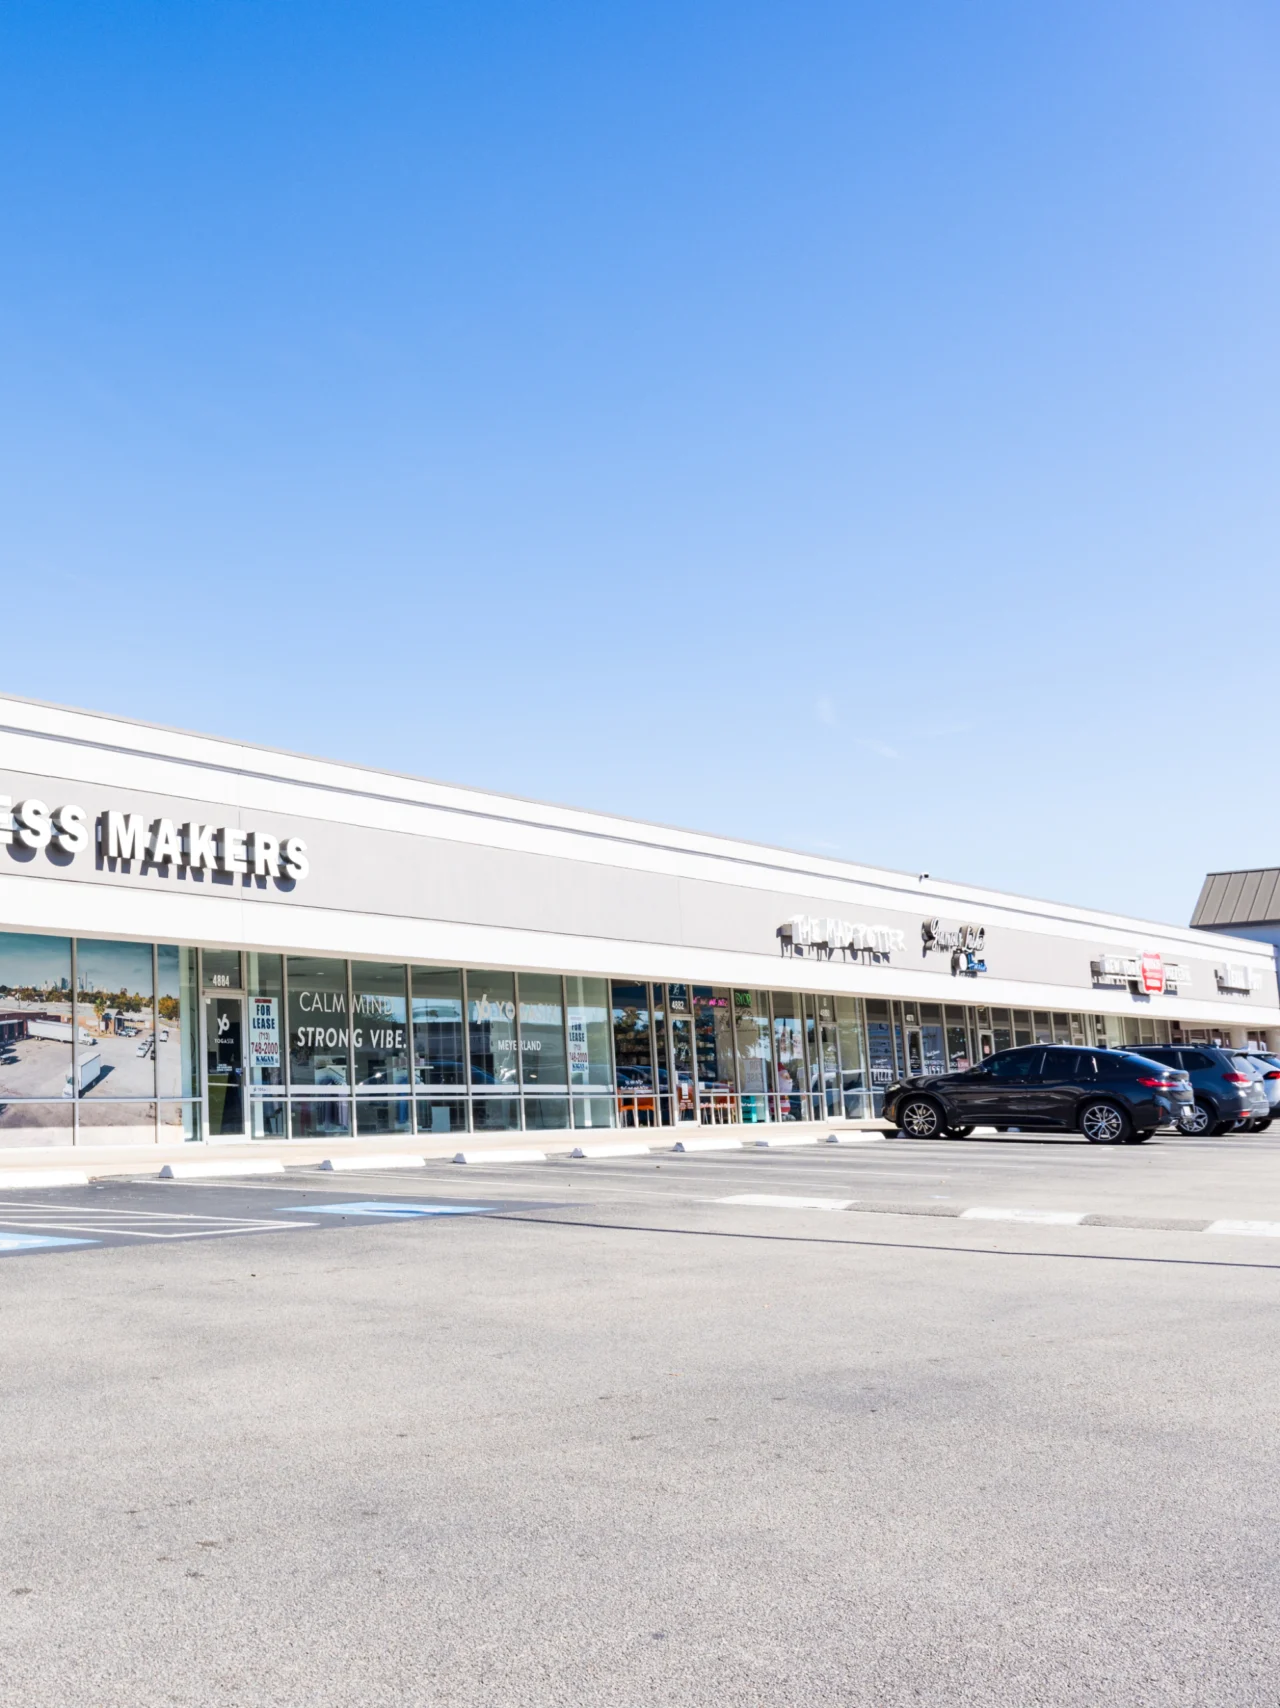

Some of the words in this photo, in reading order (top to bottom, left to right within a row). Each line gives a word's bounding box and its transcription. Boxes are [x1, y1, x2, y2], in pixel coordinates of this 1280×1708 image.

[101, 810, 309, 881] MAKERS
[212, 974, 230, 987] 4884
[300, 991, 346, 1013] CALM
[351, 994, 394, 1015] MIND
[671, 1000, 685, 1010] 4882
[256, 1004, 271, 1016] FOR
[252, 1018, 275, 1030] LEASE
[258, 1032, 270, 1041] (713)
[297, 1026, 363, 1048] STRONG
[369, 1029, 407, 1049] VIBE.
[568, 1032, 585, 1042] LEASE
[250, 1042, 279, 1055] 748-2000
[498, 1039, 542, 1051] MEYERLAND
